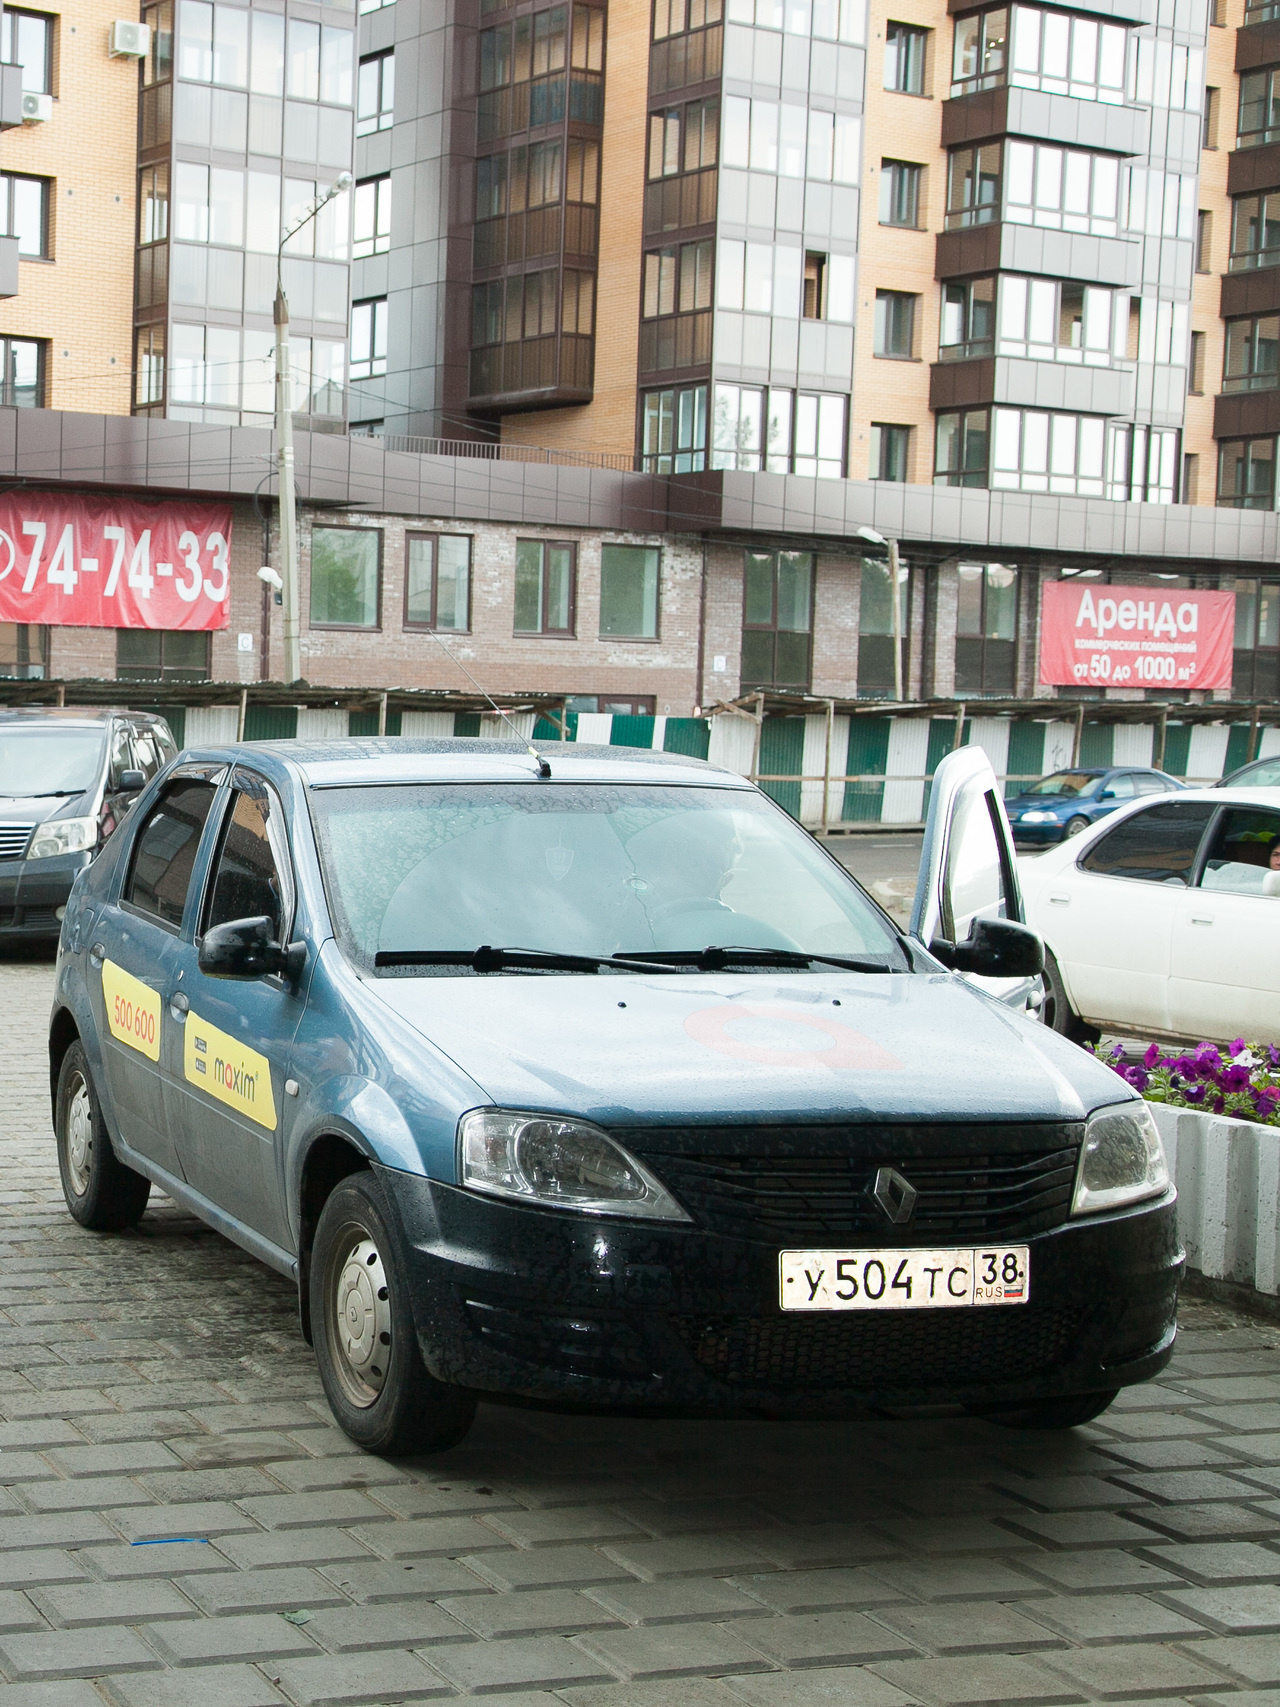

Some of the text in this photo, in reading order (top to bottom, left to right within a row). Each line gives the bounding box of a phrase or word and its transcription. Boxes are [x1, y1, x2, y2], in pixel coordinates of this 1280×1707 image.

[22, 520, 229, 602] 74-74-33
[1075, 588, 1198, 638] Аренда
[1073, 663, 1088, 678] от
[1090, 654, 1111, 679] 50
[1112, 665, 1131, 681] до
[1134, 656, 1175, 680] 1000
[114, 995, 155, 1044] 500 600
[214, 1057, 255, 1102] maxim
[981, 1253, 1018, 1284] 38
[975, 1286, 1002, 1298] RUS
